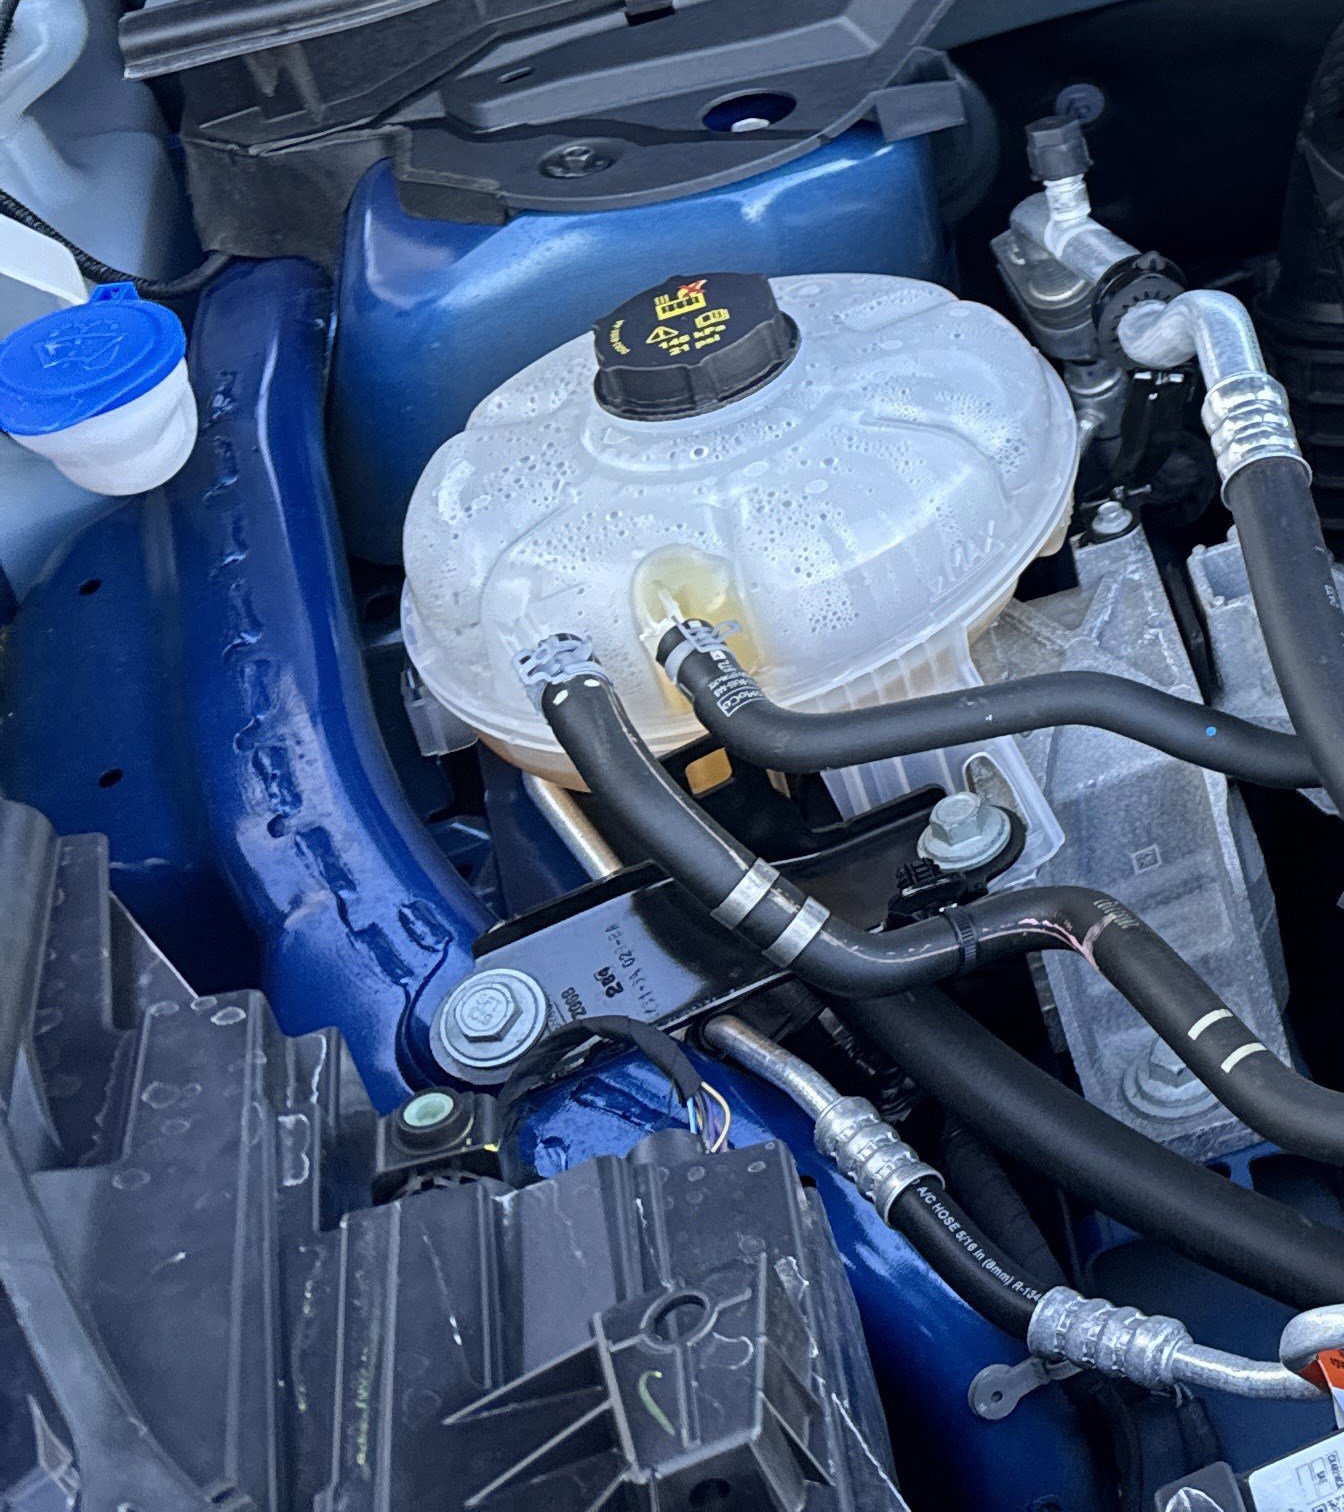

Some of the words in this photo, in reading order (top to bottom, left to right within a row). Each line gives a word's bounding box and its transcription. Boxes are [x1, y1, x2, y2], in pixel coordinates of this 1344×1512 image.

[916, 1186, 937, 1204] A/C
[932, 1202, 961, 1232] HOSE
[955, 1230, 978, 1252] 5/16
